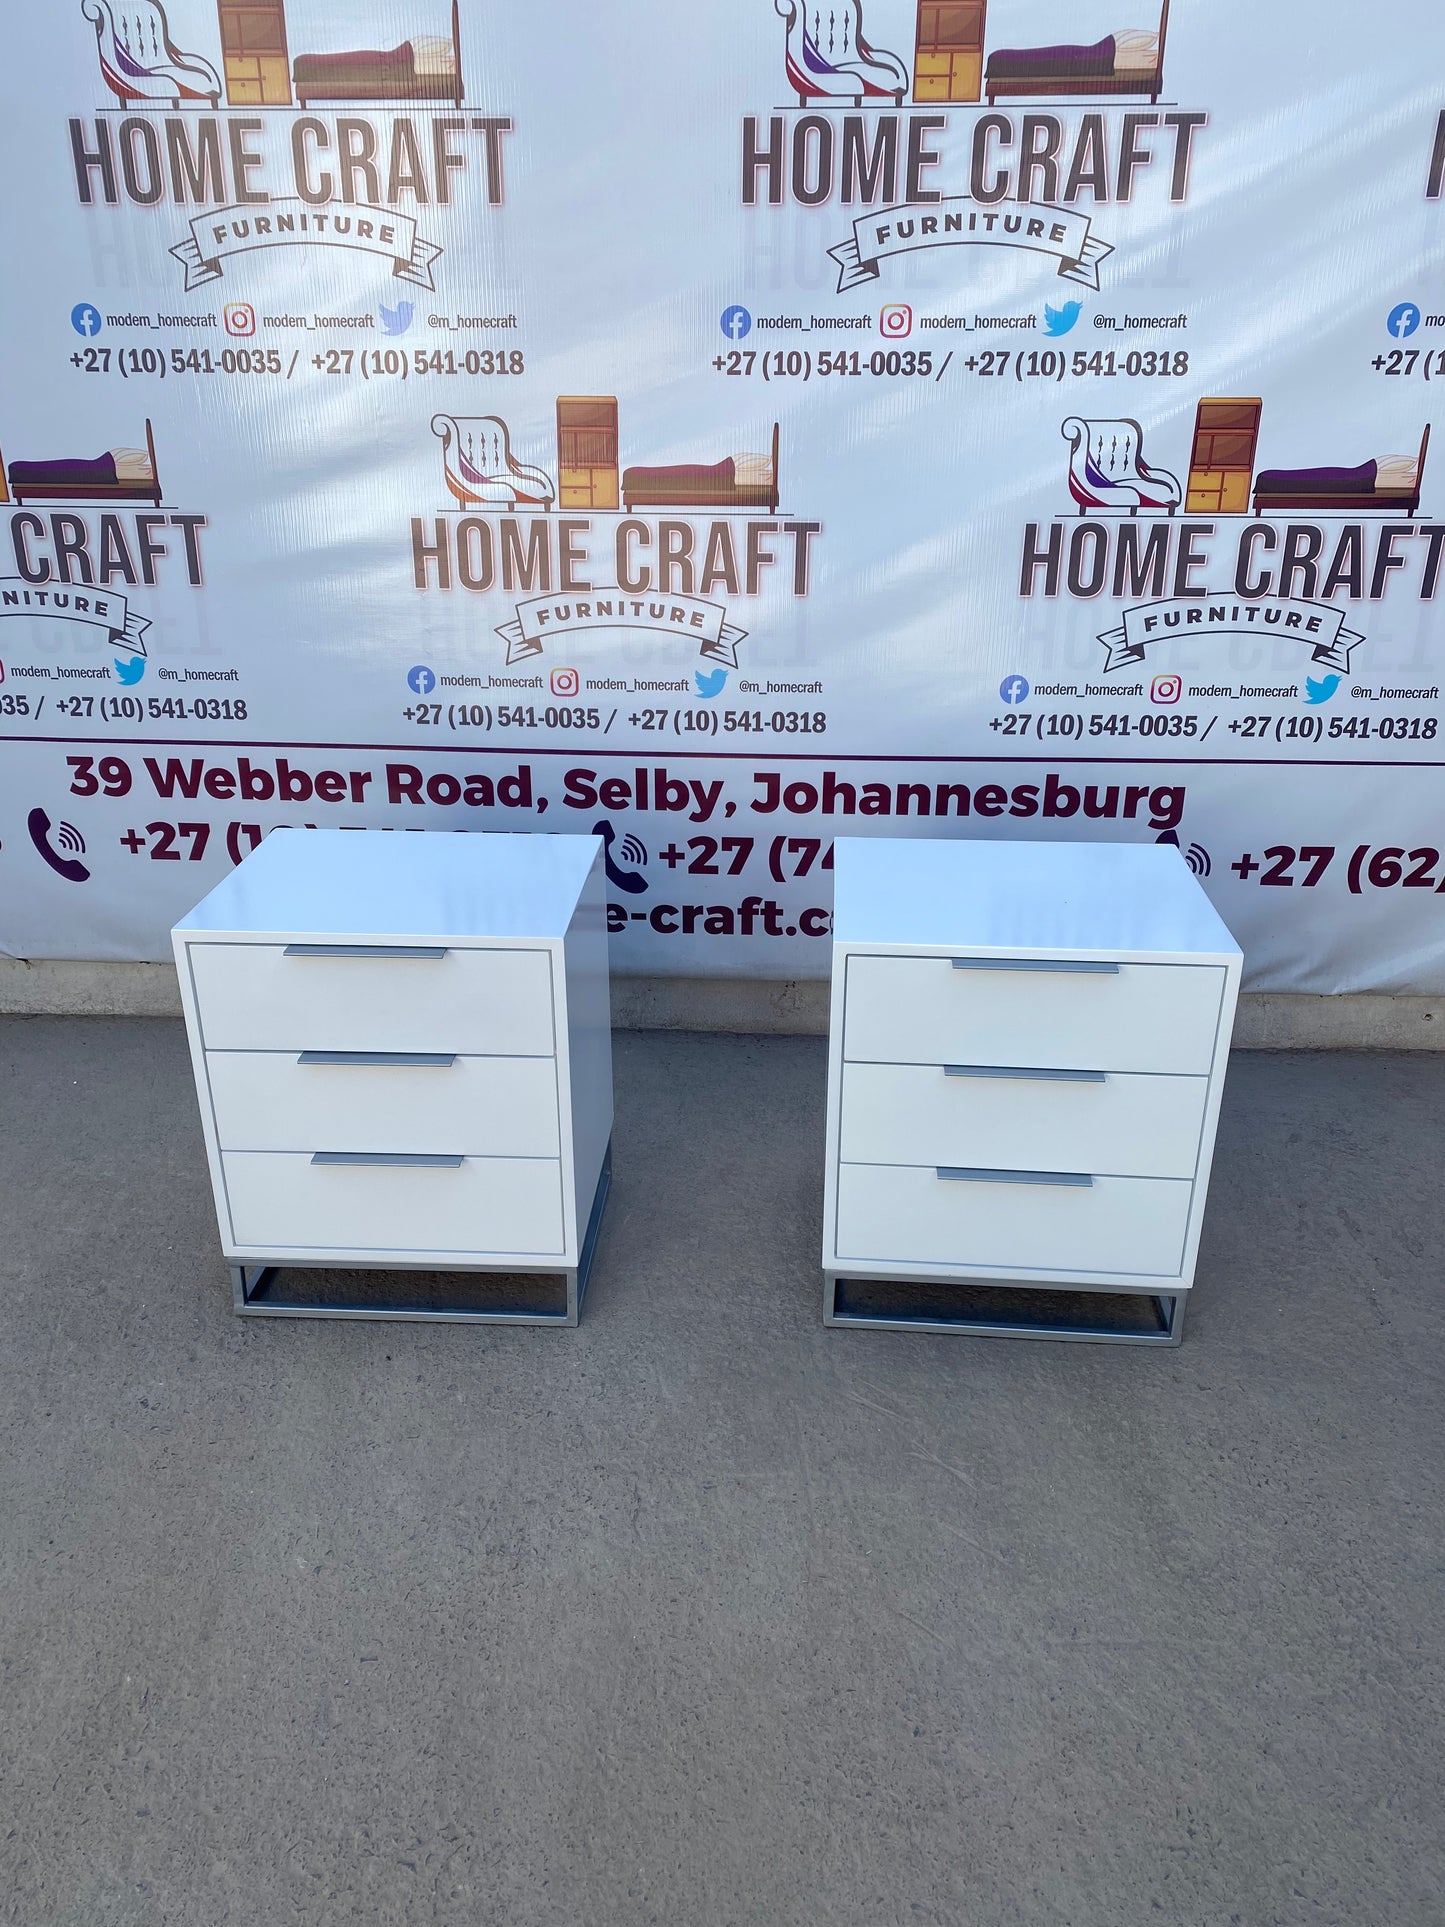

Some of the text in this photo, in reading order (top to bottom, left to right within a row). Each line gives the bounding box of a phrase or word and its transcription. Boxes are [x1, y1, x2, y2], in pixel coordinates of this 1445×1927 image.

[68, 117, 512, 205] HOME CRAFT
[741, 113, 1206, 205] HOME CRAFT
[212, 214, 395, 245] FURNITURE
[876, 213, 1068, 245] FURNITURE
[427, 313, 517, 331] @m_homecraft
[1093, 314, 1187, 332] @m_homecraft
[70, 348, 524, 380] +27 (10) 541-0035 / +27 (10) 541-0318
[712, 351, 1189, 381] +27 (10) 541-0035 / +27 (10) 541-0318
[1372, 350, 1420, 375] +27
[11, 512, 206, 585] CRAFT
[410, 518, 821, 595] HOME CRAFT
[1020, 524, 1445, 599] HOME CRAFT
[536, 601, 705, 628] FURNITURE
[1144, 607, 1322, 632] FURNITURE
[159, 668, 239, 682] @m_homecraft
[739, 680, 822, 695] @m_homecraft
[1351, 686, 1439, 700] @m_homecraft
[56, 697, 94, 716] +27
[101, 698, 143, 722] (10)
[149, 698, 247, 720] 541-0318
[403, 704, 826, 734] +27 (10) 541-0035 / +27 (10) 541-0318
[989, 714, 1437, 741] +27 (10) 541-0035 / +27 (10) 541-0318
[66, 756, 1186, 830] 39 Webber Road, Selby, Johannesburg
[120, 822, 210, 861] +27
[659, 836, 754, 875] +27
[1231, 845, 1335, 887] +27
